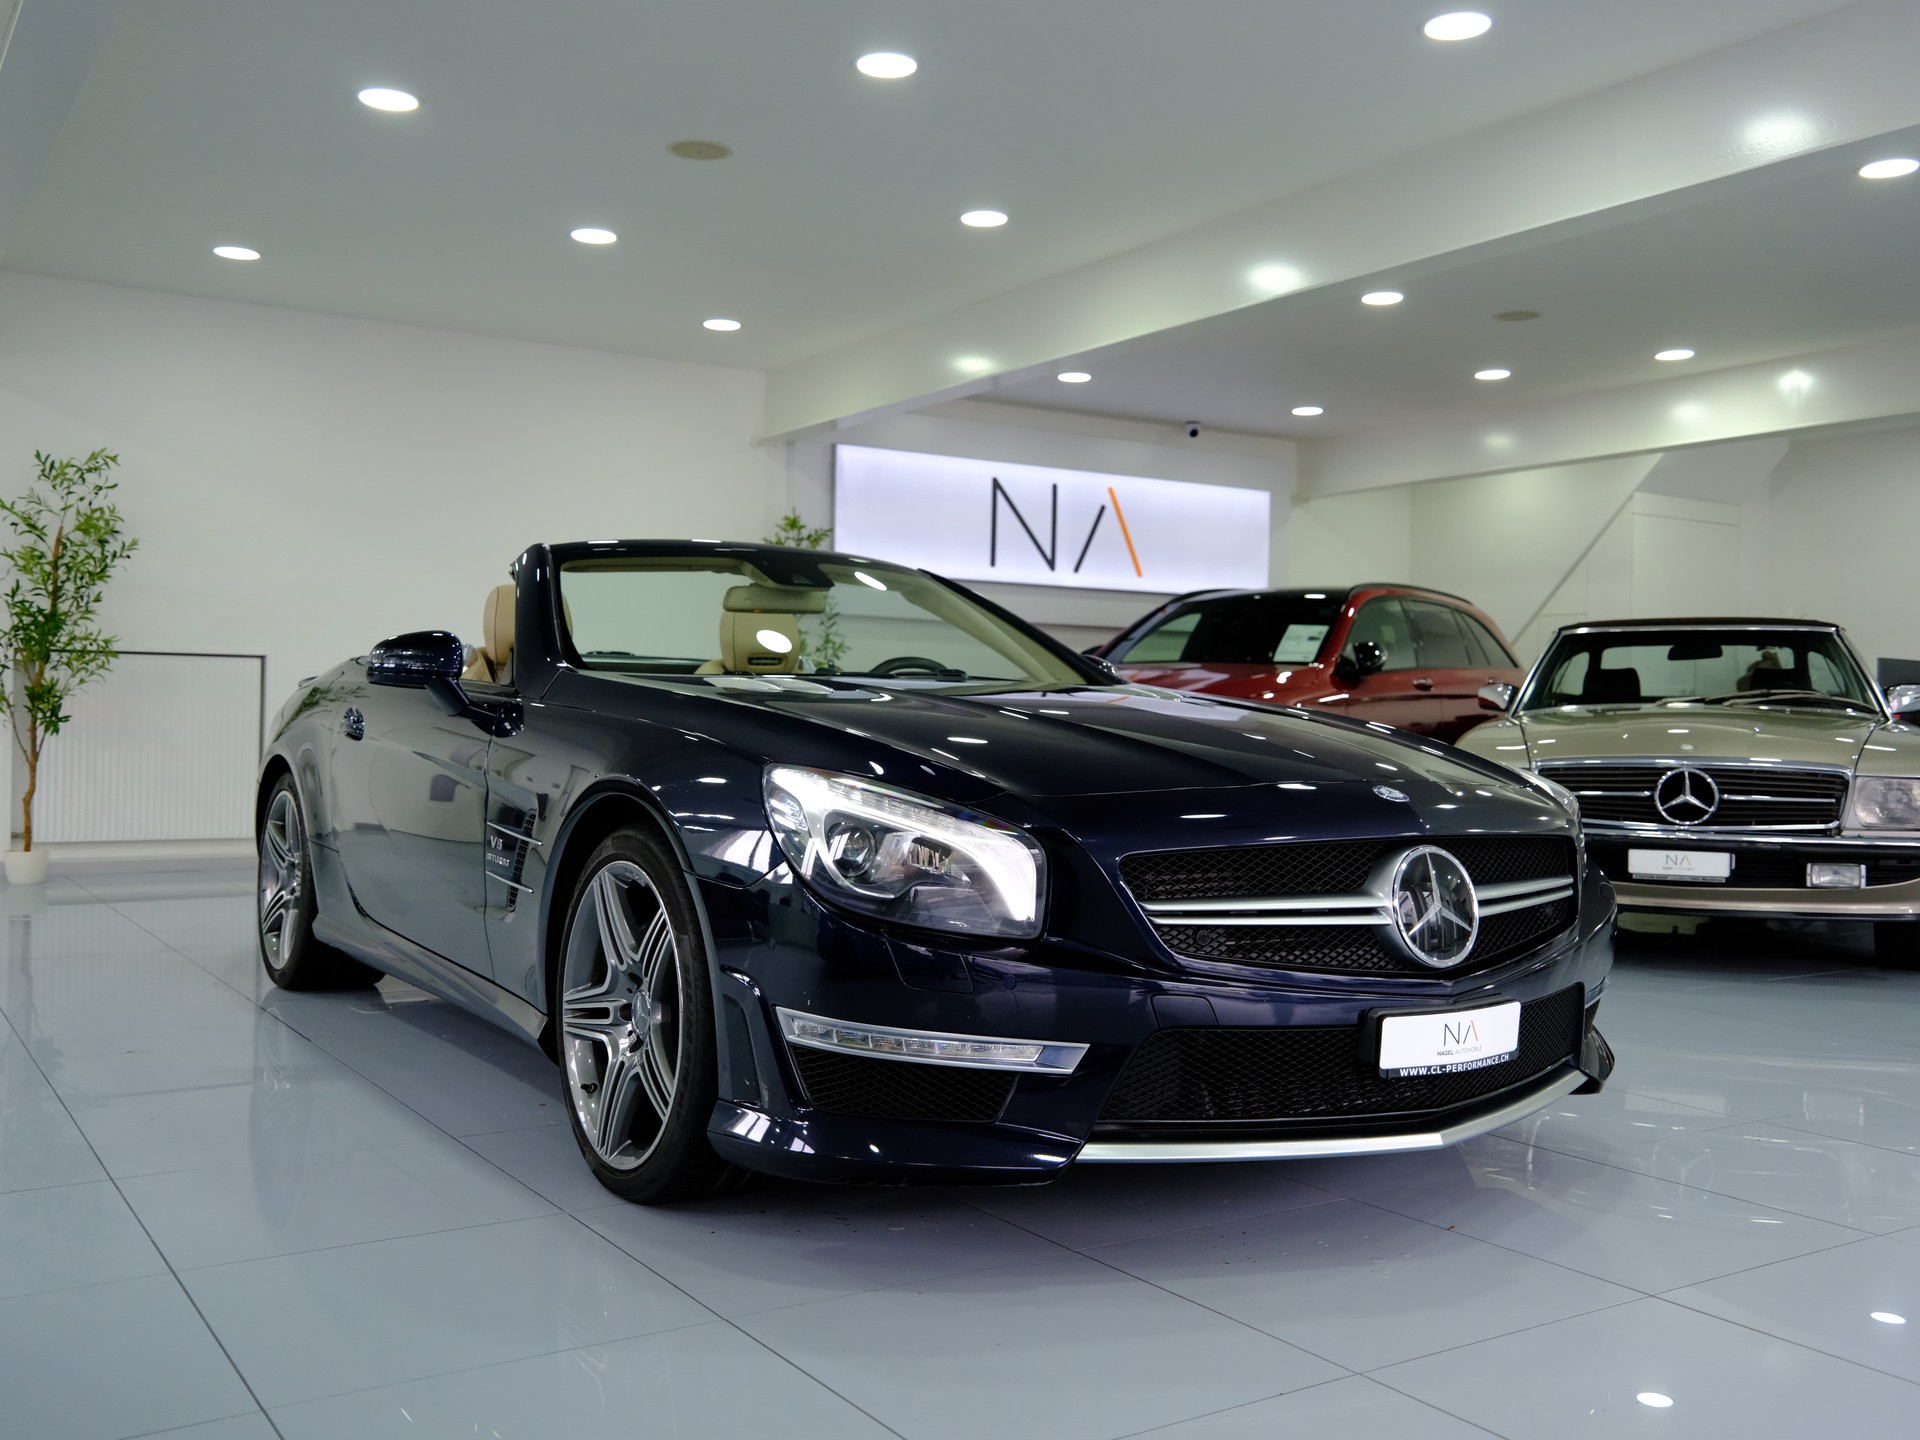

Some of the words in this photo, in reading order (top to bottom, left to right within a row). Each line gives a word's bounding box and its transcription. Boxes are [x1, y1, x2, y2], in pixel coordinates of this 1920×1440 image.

[990, 477, 1143, 577] NA
[1443, 1019, 1479, 1046] NA
[1399, 1053, 1509, 1077] WWW.CL-PERFORMANCE.CH
[1436, 1049, 1454, 1057] NAGEL
